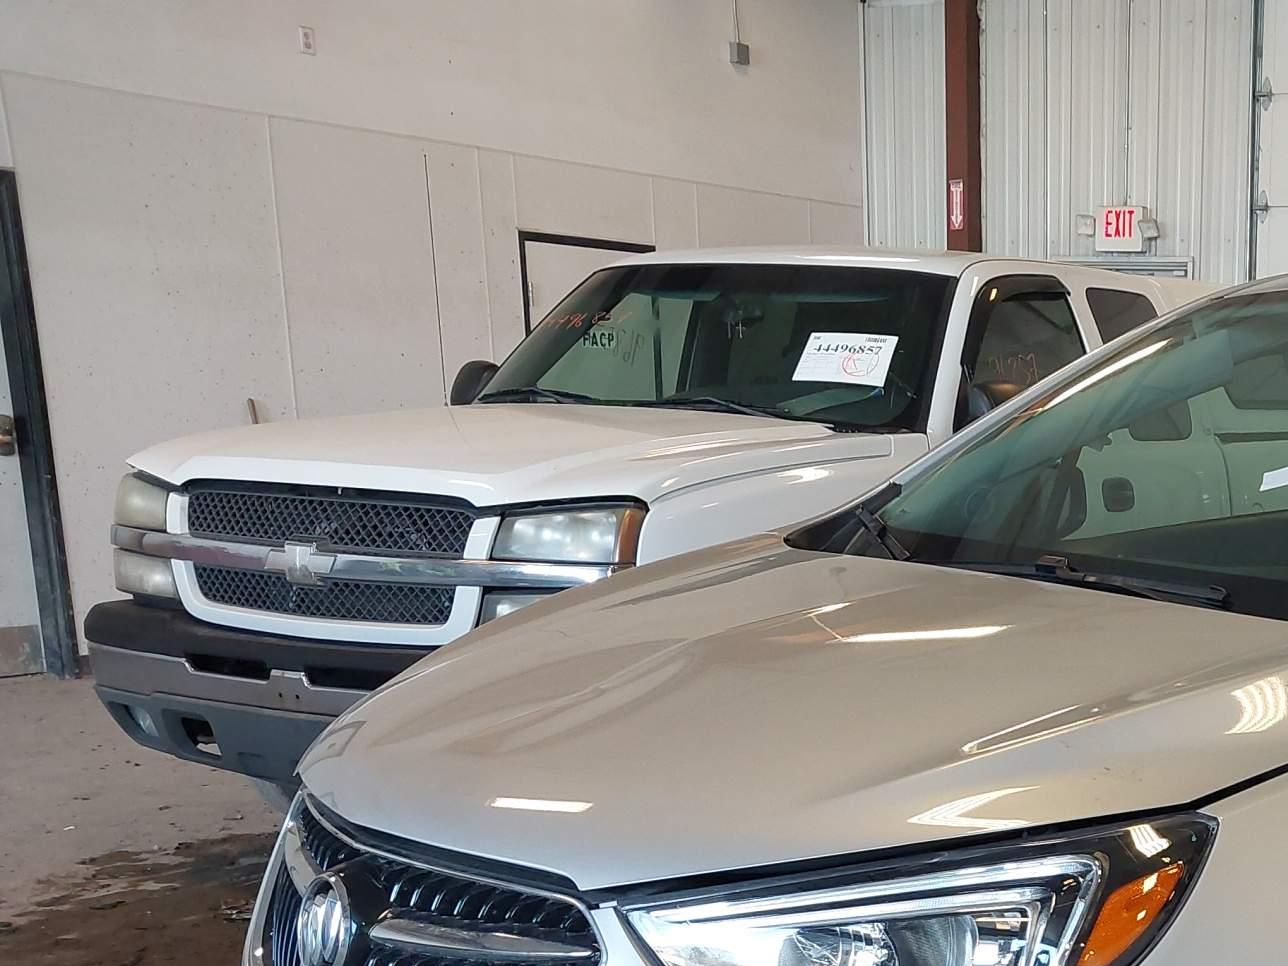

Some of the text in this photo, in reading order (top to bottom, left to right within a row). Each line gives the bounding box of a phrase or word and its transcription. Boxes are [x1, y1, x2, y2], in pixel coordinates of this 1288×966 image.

[1104, 209, 1135, 238] EXIT
[582, 331, 615, 348] FACP
[813, 343, 882, 355] 44496857
